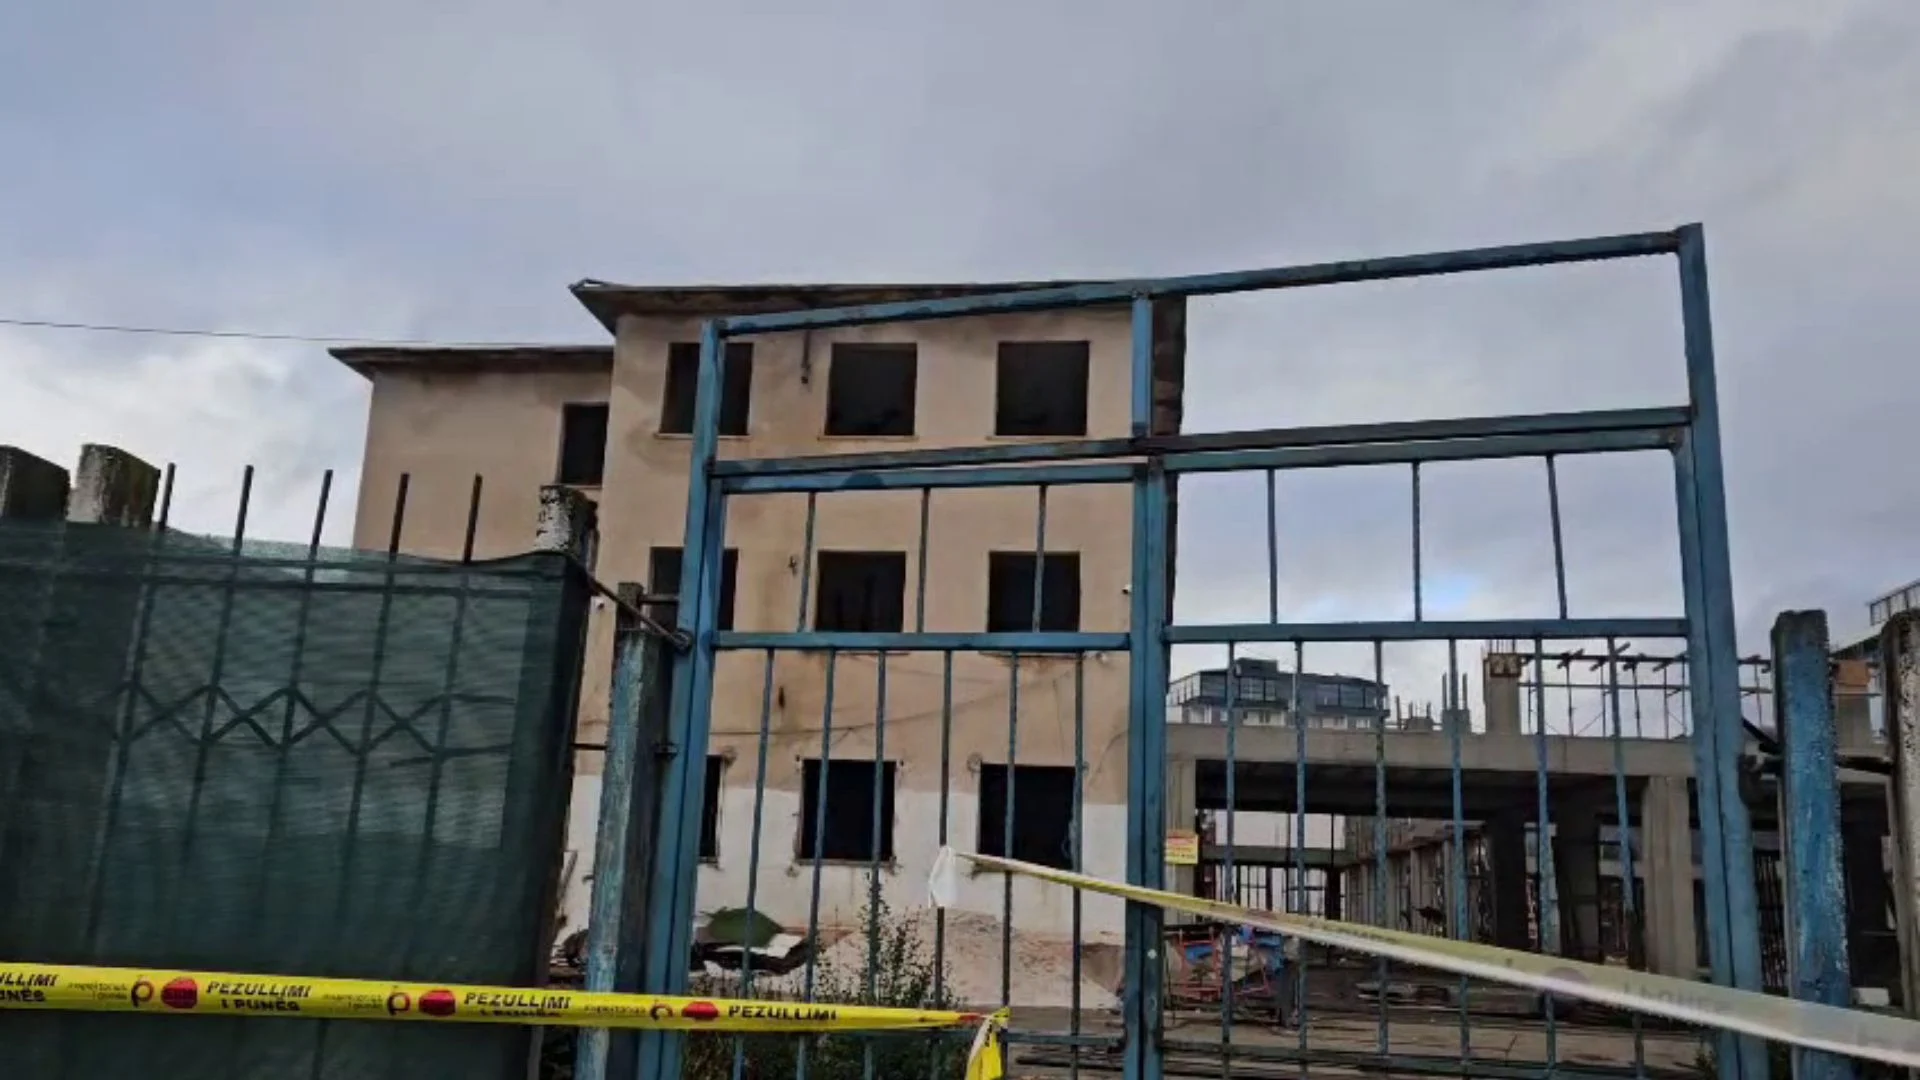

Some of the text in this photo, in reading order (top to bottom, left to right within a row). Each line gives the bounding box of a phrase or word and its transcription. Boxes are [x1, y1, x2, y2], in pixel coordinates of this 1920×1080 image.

[206, 981, 312, 998] PEZULLIMI
[464, 991, 571, 1009] PEZULLIMI
[728, 1005, 837, 1020] PEZULLIMI
